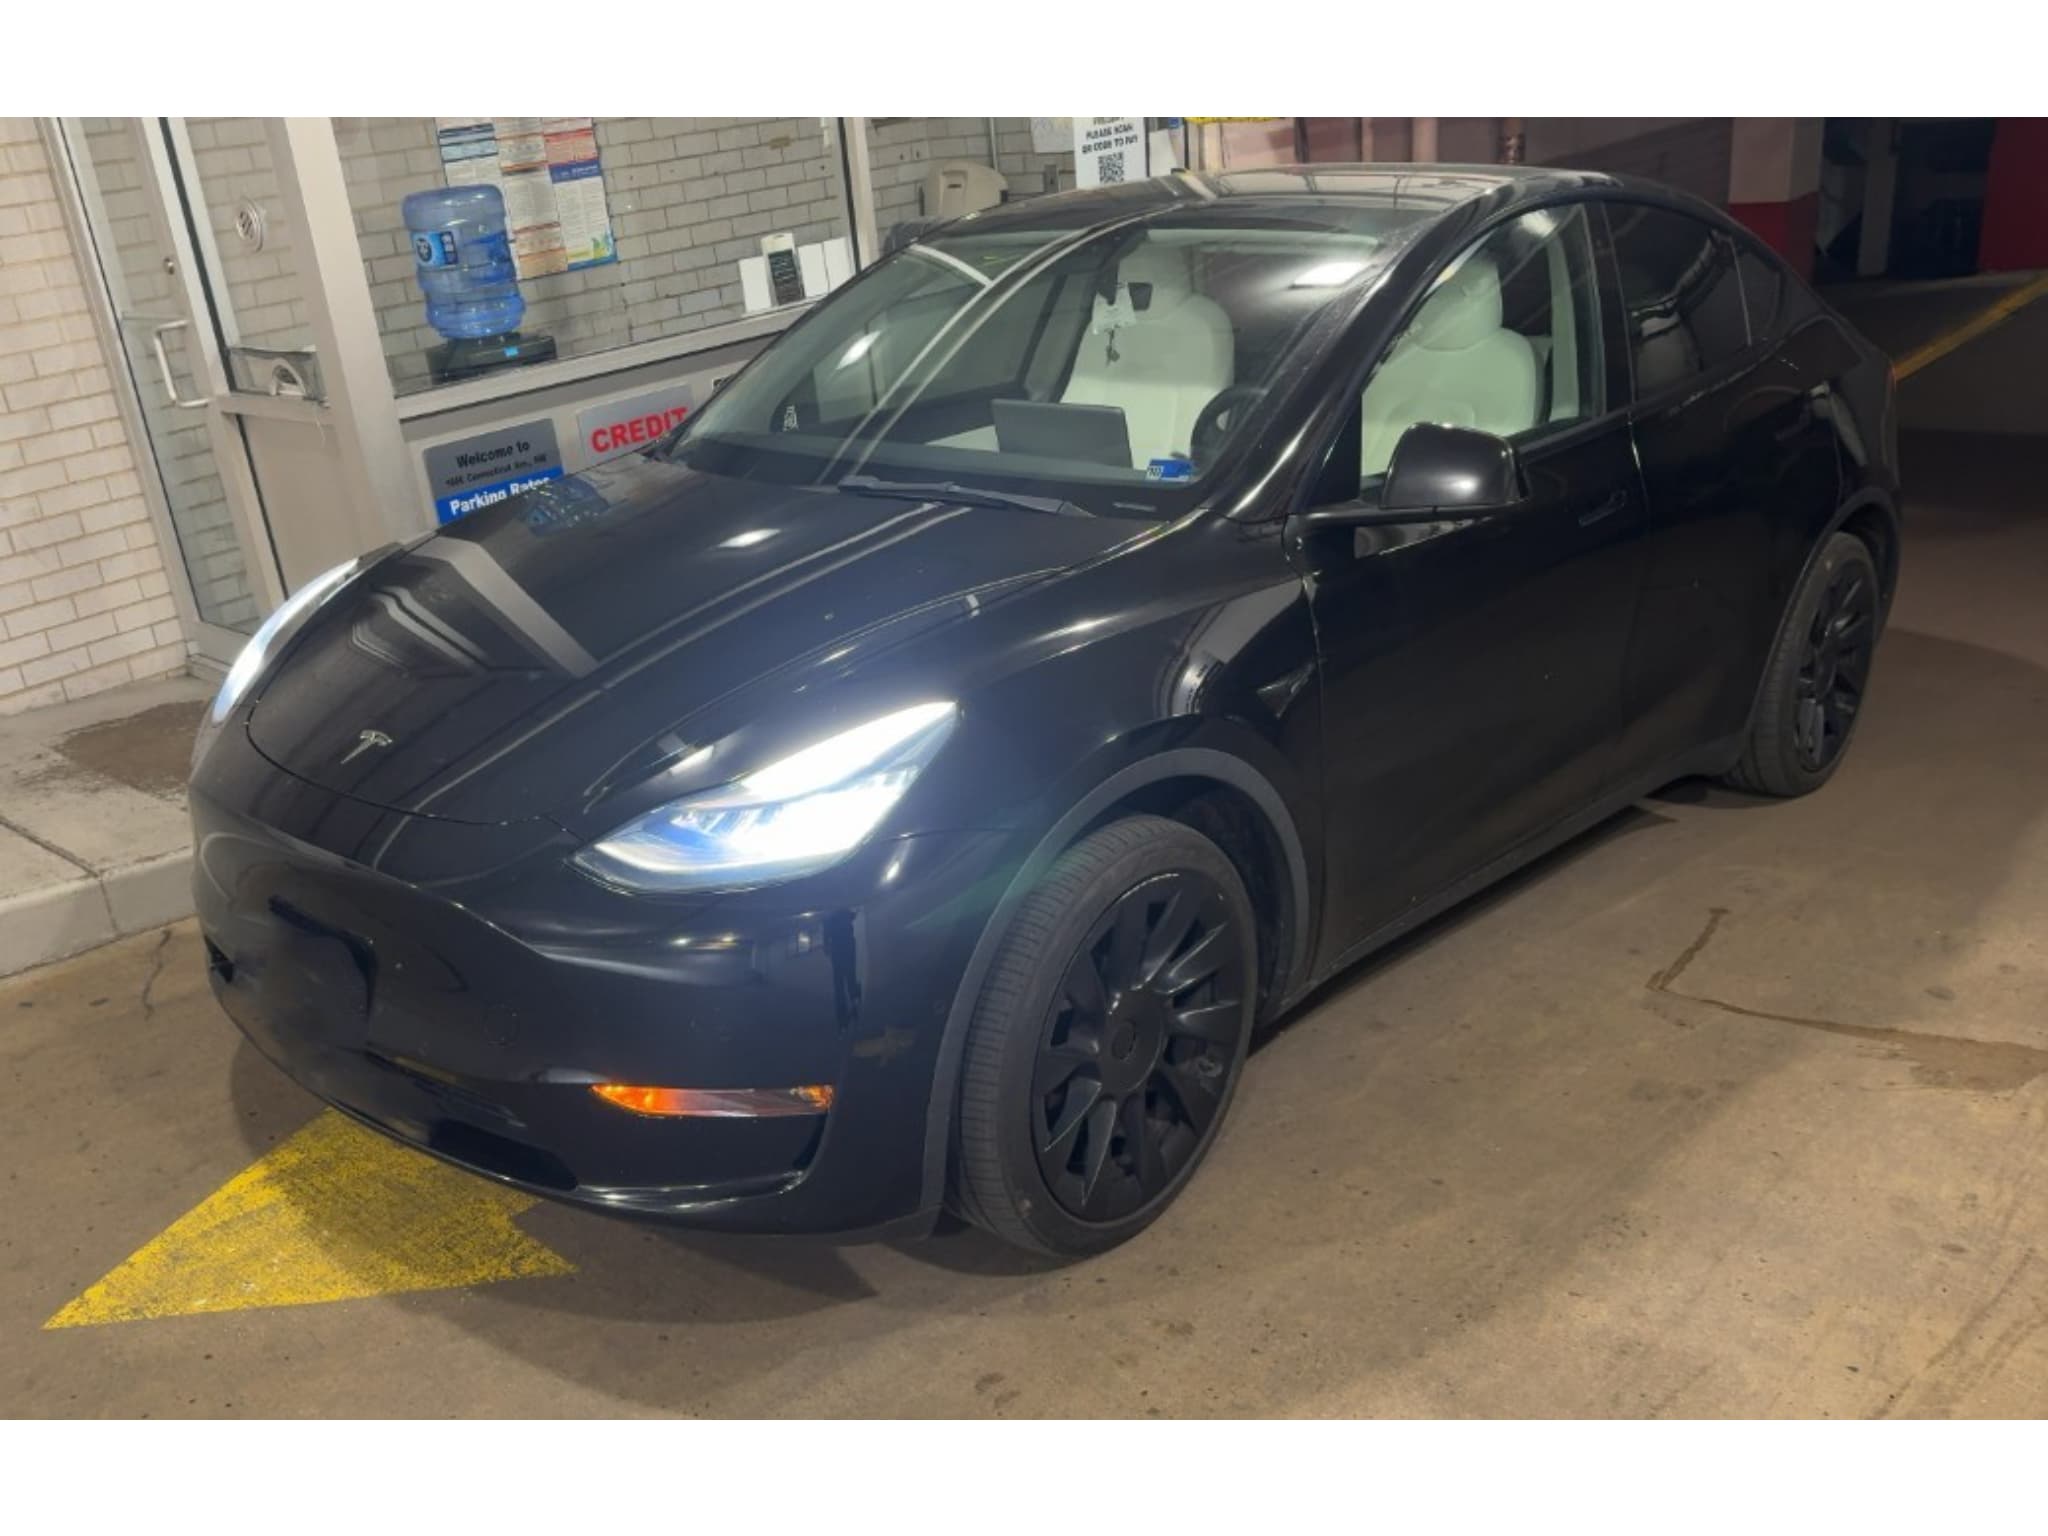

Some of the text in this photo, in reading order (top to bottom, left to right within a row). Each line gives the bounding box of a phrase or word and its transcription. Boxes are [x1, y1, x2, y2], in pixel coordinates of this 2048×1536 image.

[591, 406, 688, 453] CREDIT
[456, 441, 530, 468] Welcome to
[449, 490, 507, 516] Parking
